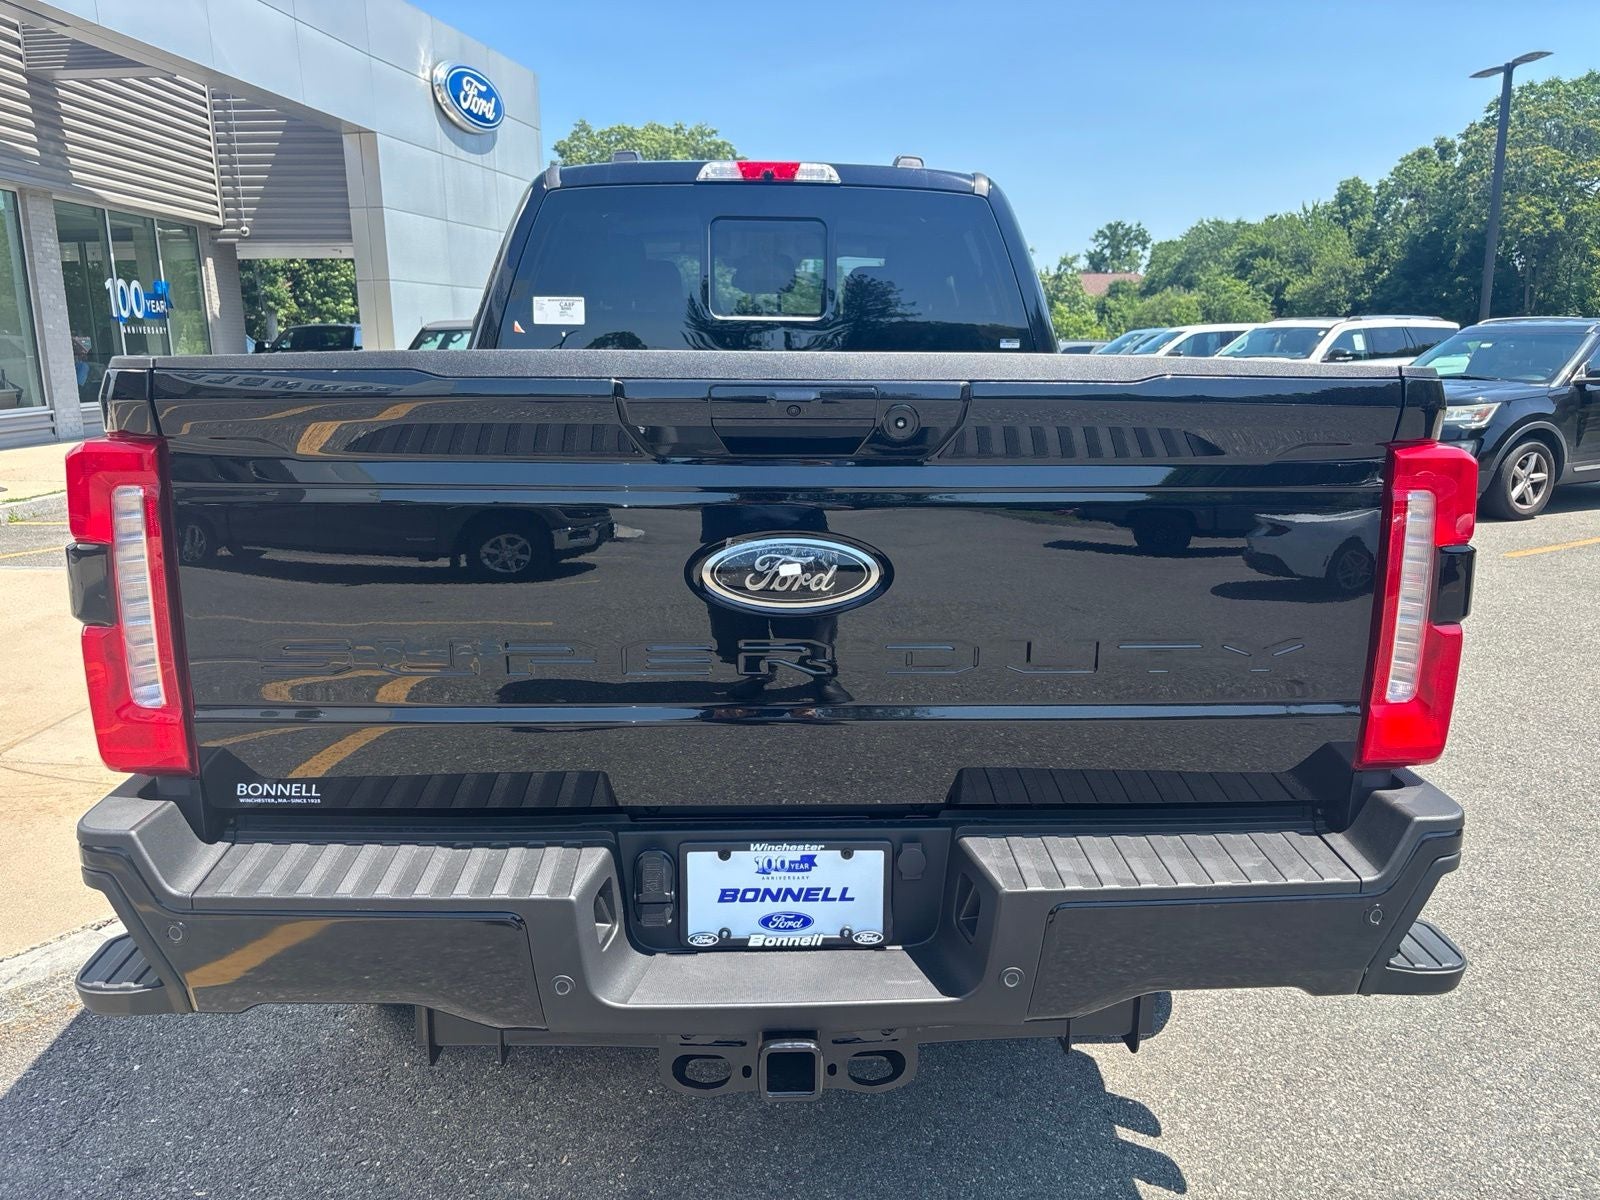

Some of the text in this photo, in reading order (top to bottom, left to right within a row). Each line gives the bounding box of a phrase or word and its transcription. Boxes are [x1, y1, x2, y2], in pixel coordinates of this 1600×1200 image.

[459, 76, 496, 120] Ford
[105, 278, 168, 318] 100 YEAR
[122, 326, 167, 334] ANNIVERSARY
[744, 554, 838, 592] Ford
[259, 638, 1306, 676] SUPER DUTY
[236, 783, 321, 796] BONNELL
[750, 843, 825, 851] Winchester
[754, 855, 790, 873] 100
[717, 887, 856, 903] BONNELL
[768, 914, 804, 929] Ford
[747, 934, 825, 947] Bonnell
